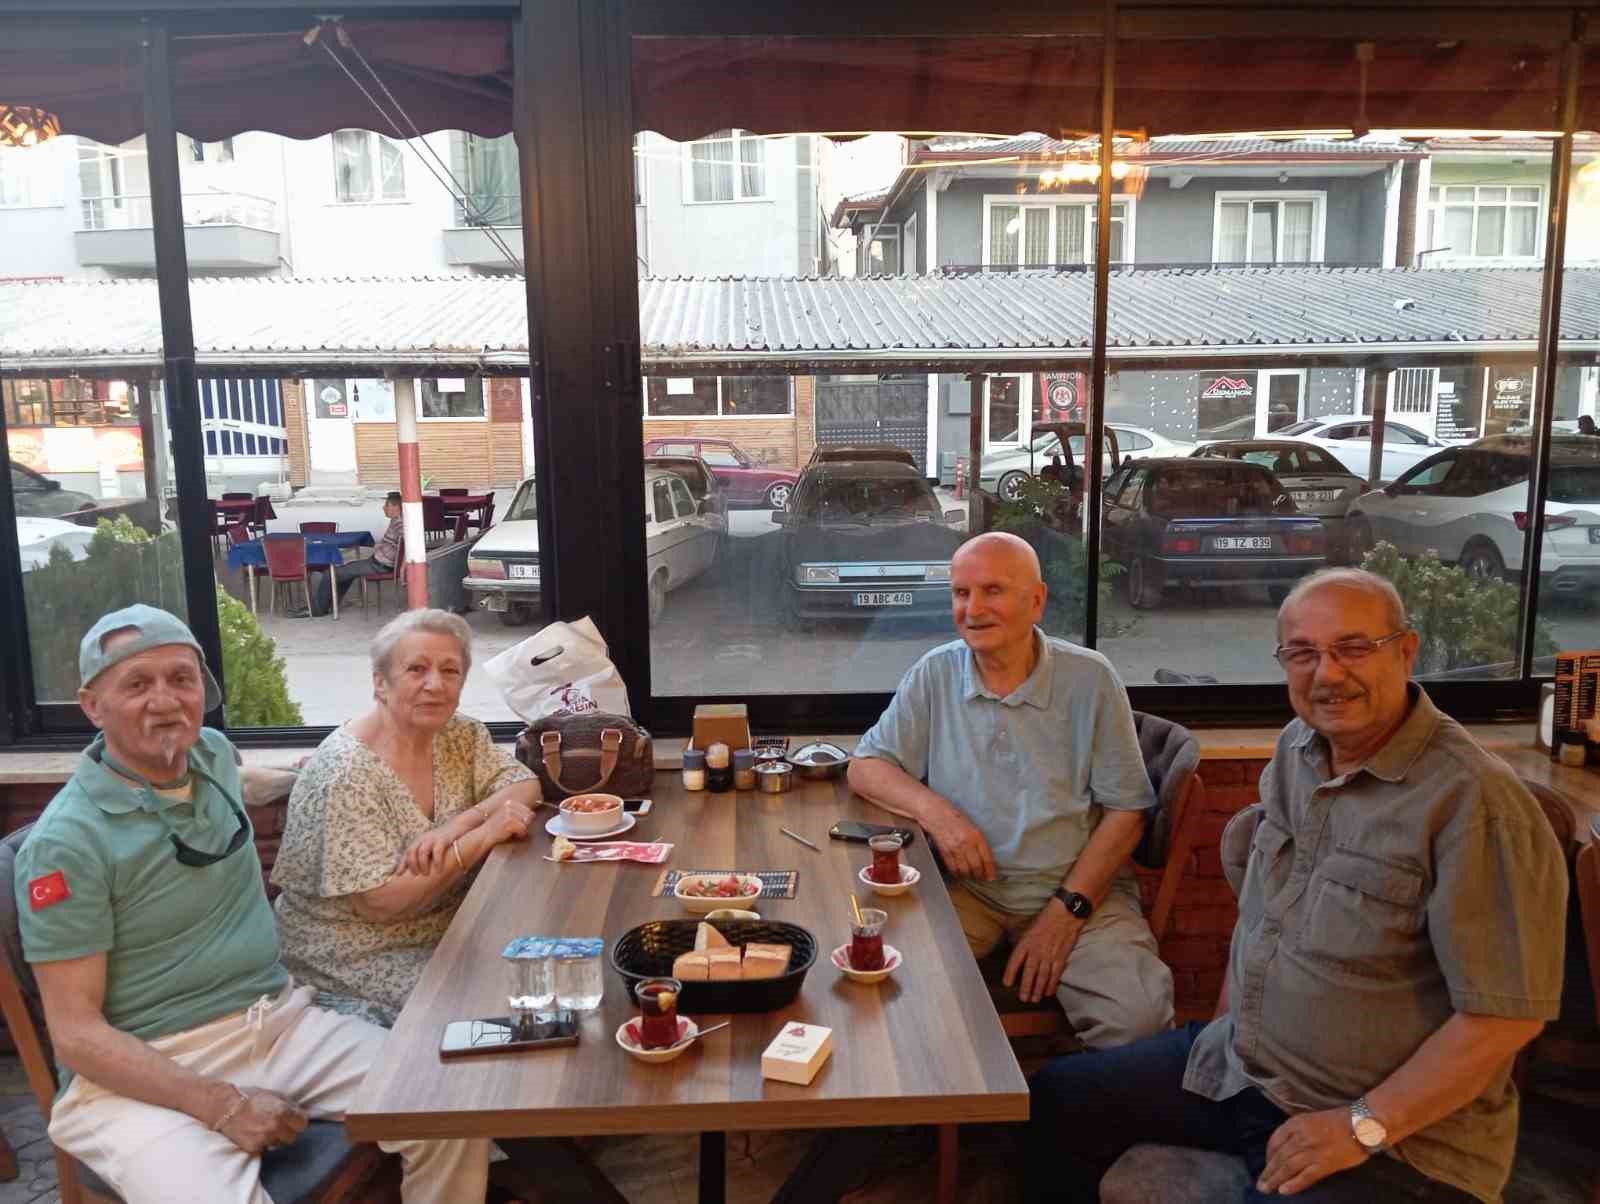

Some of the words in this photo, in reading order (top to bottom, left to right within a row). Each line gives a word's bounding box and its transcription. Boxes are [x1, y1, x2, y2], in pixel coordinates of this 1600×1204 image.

[1218, 537, 1229, 548] 19
[1234, 537, 1246, 548] TZ
[1252, 537, 1269, 547] 839
[515, 566, 525, 577] 19
[859, 594, 870, 604] 19
[873, 594, 890, 604] ABC
